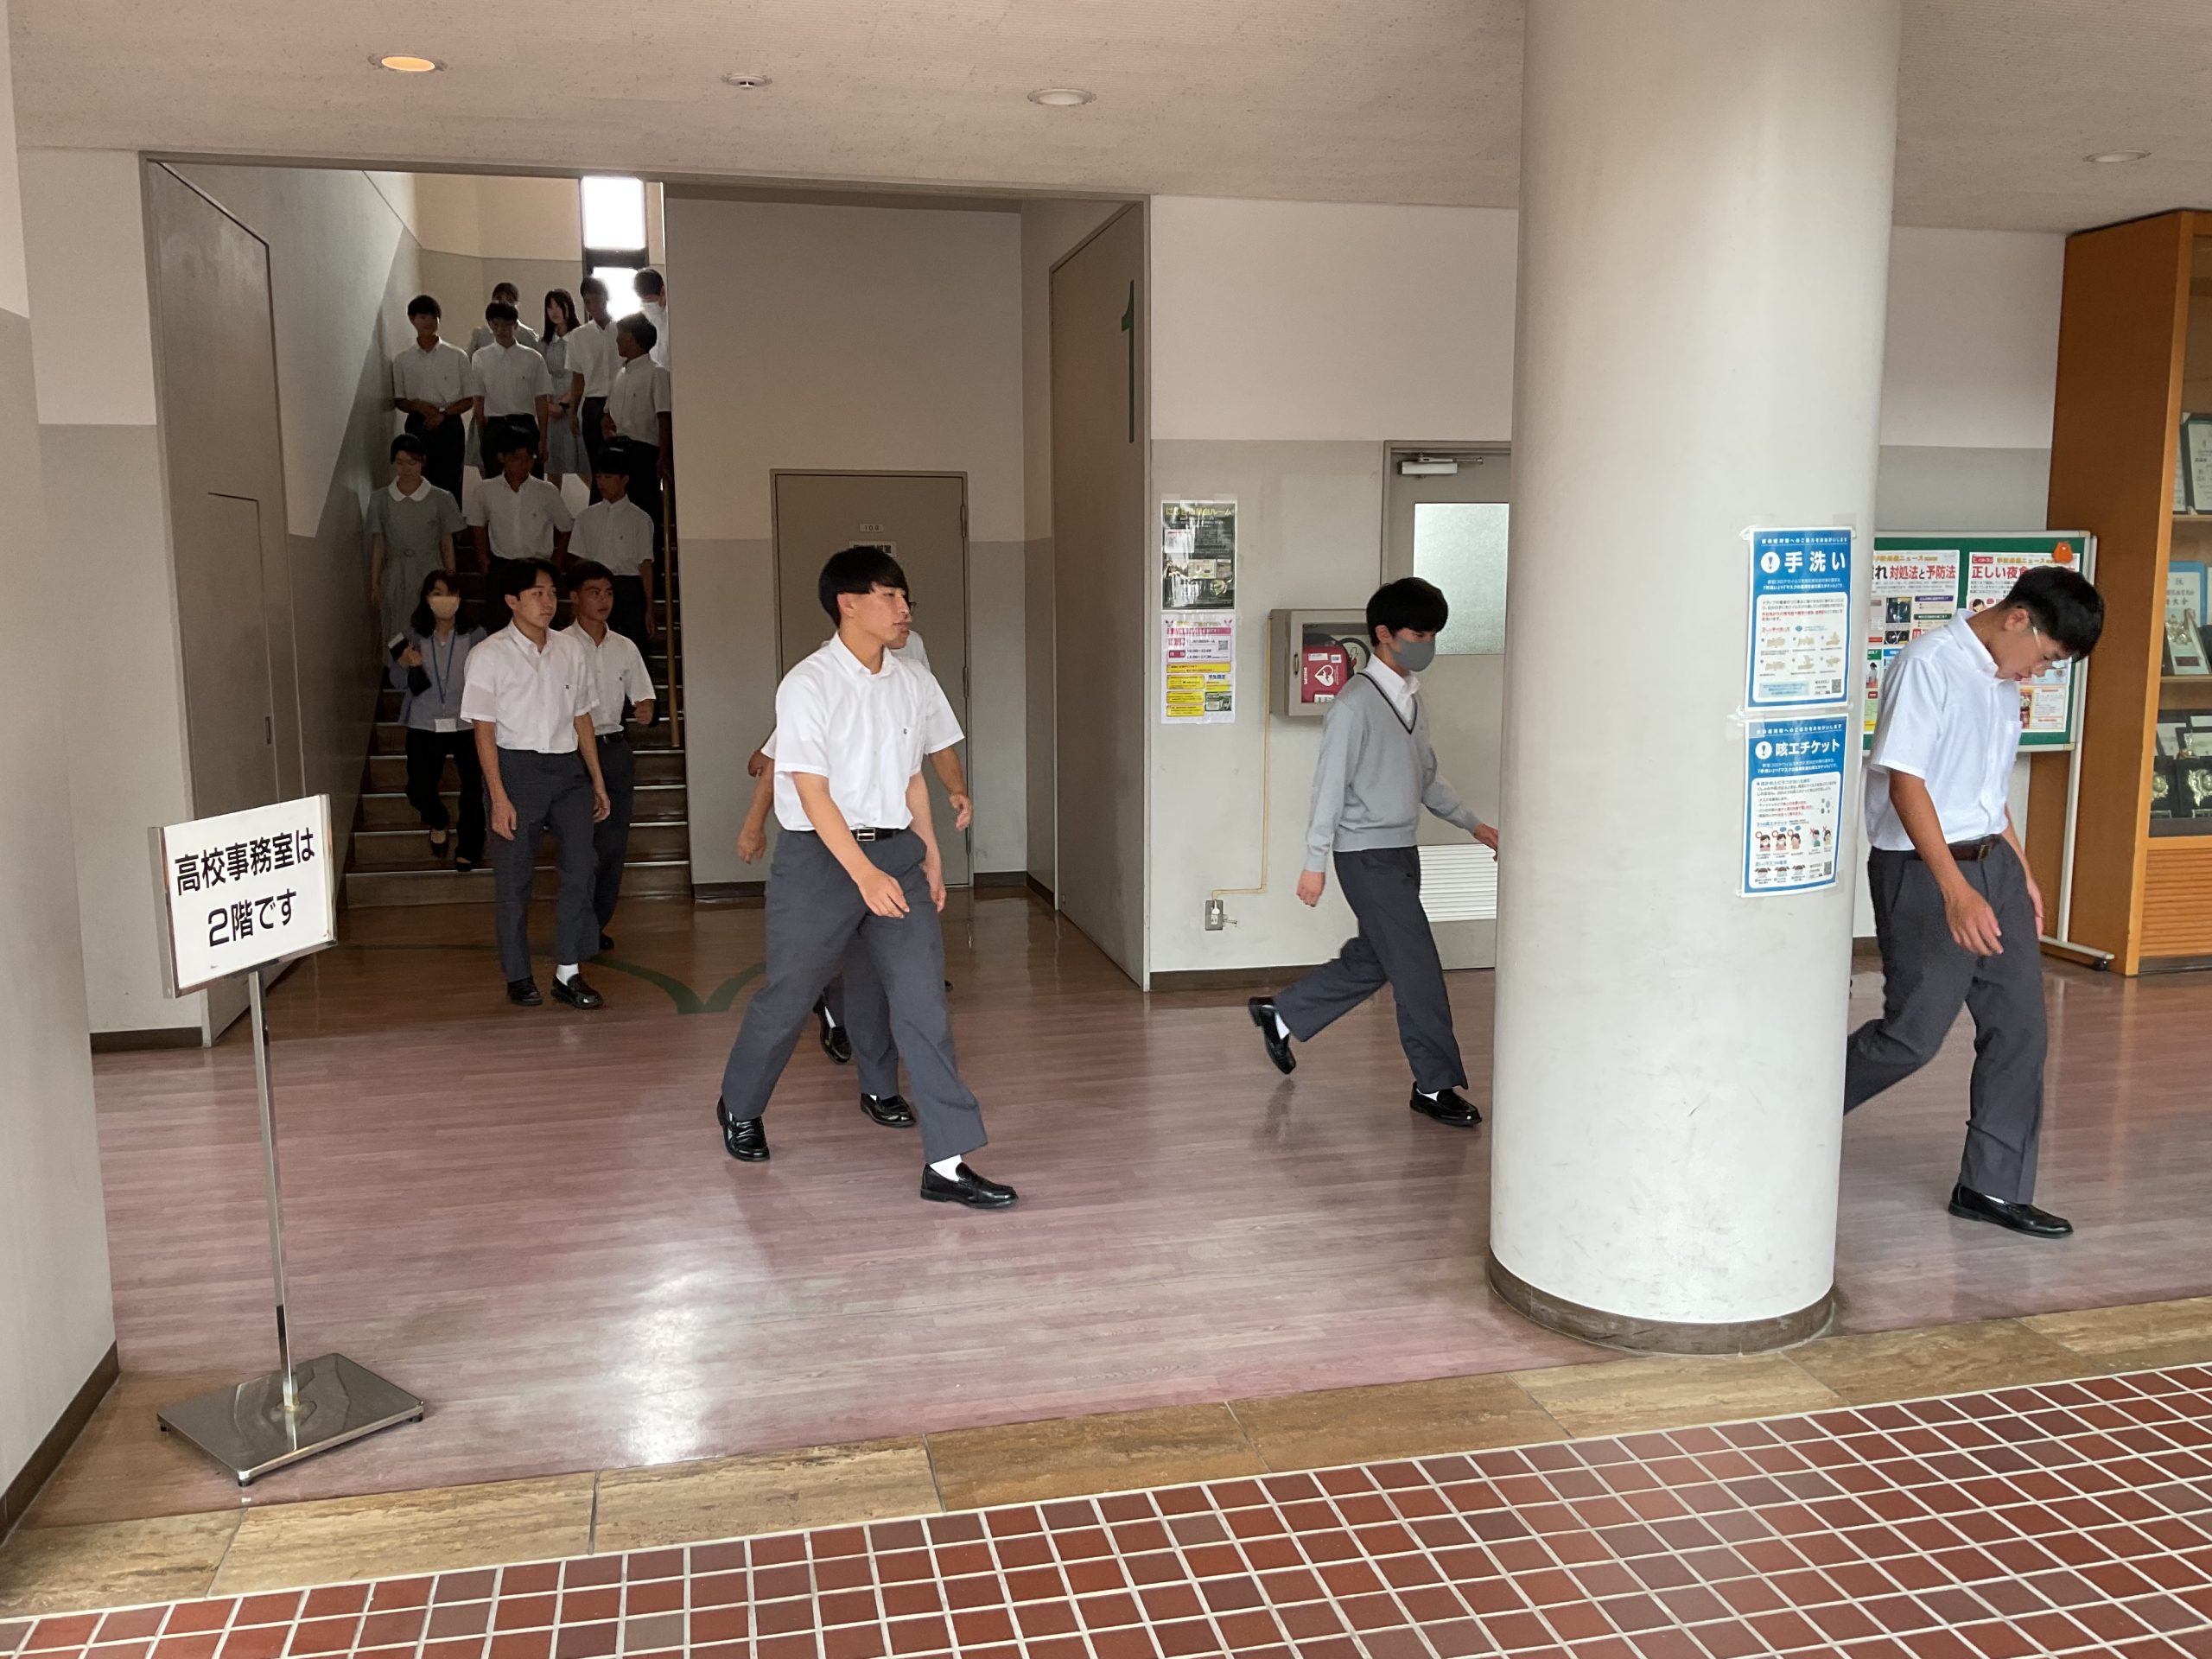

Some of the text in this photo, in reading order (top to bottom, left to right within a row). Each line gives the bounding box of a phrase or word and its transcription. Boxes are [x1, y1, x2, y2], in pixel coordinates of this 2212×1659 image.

[1784, 550, 1846, 574] 手洗い
[1775, 738, 1840, 757] 咳エチケット
[175, 827, 315, 896] 高校事務室は
[207, 888, 297, 947] 2階です
